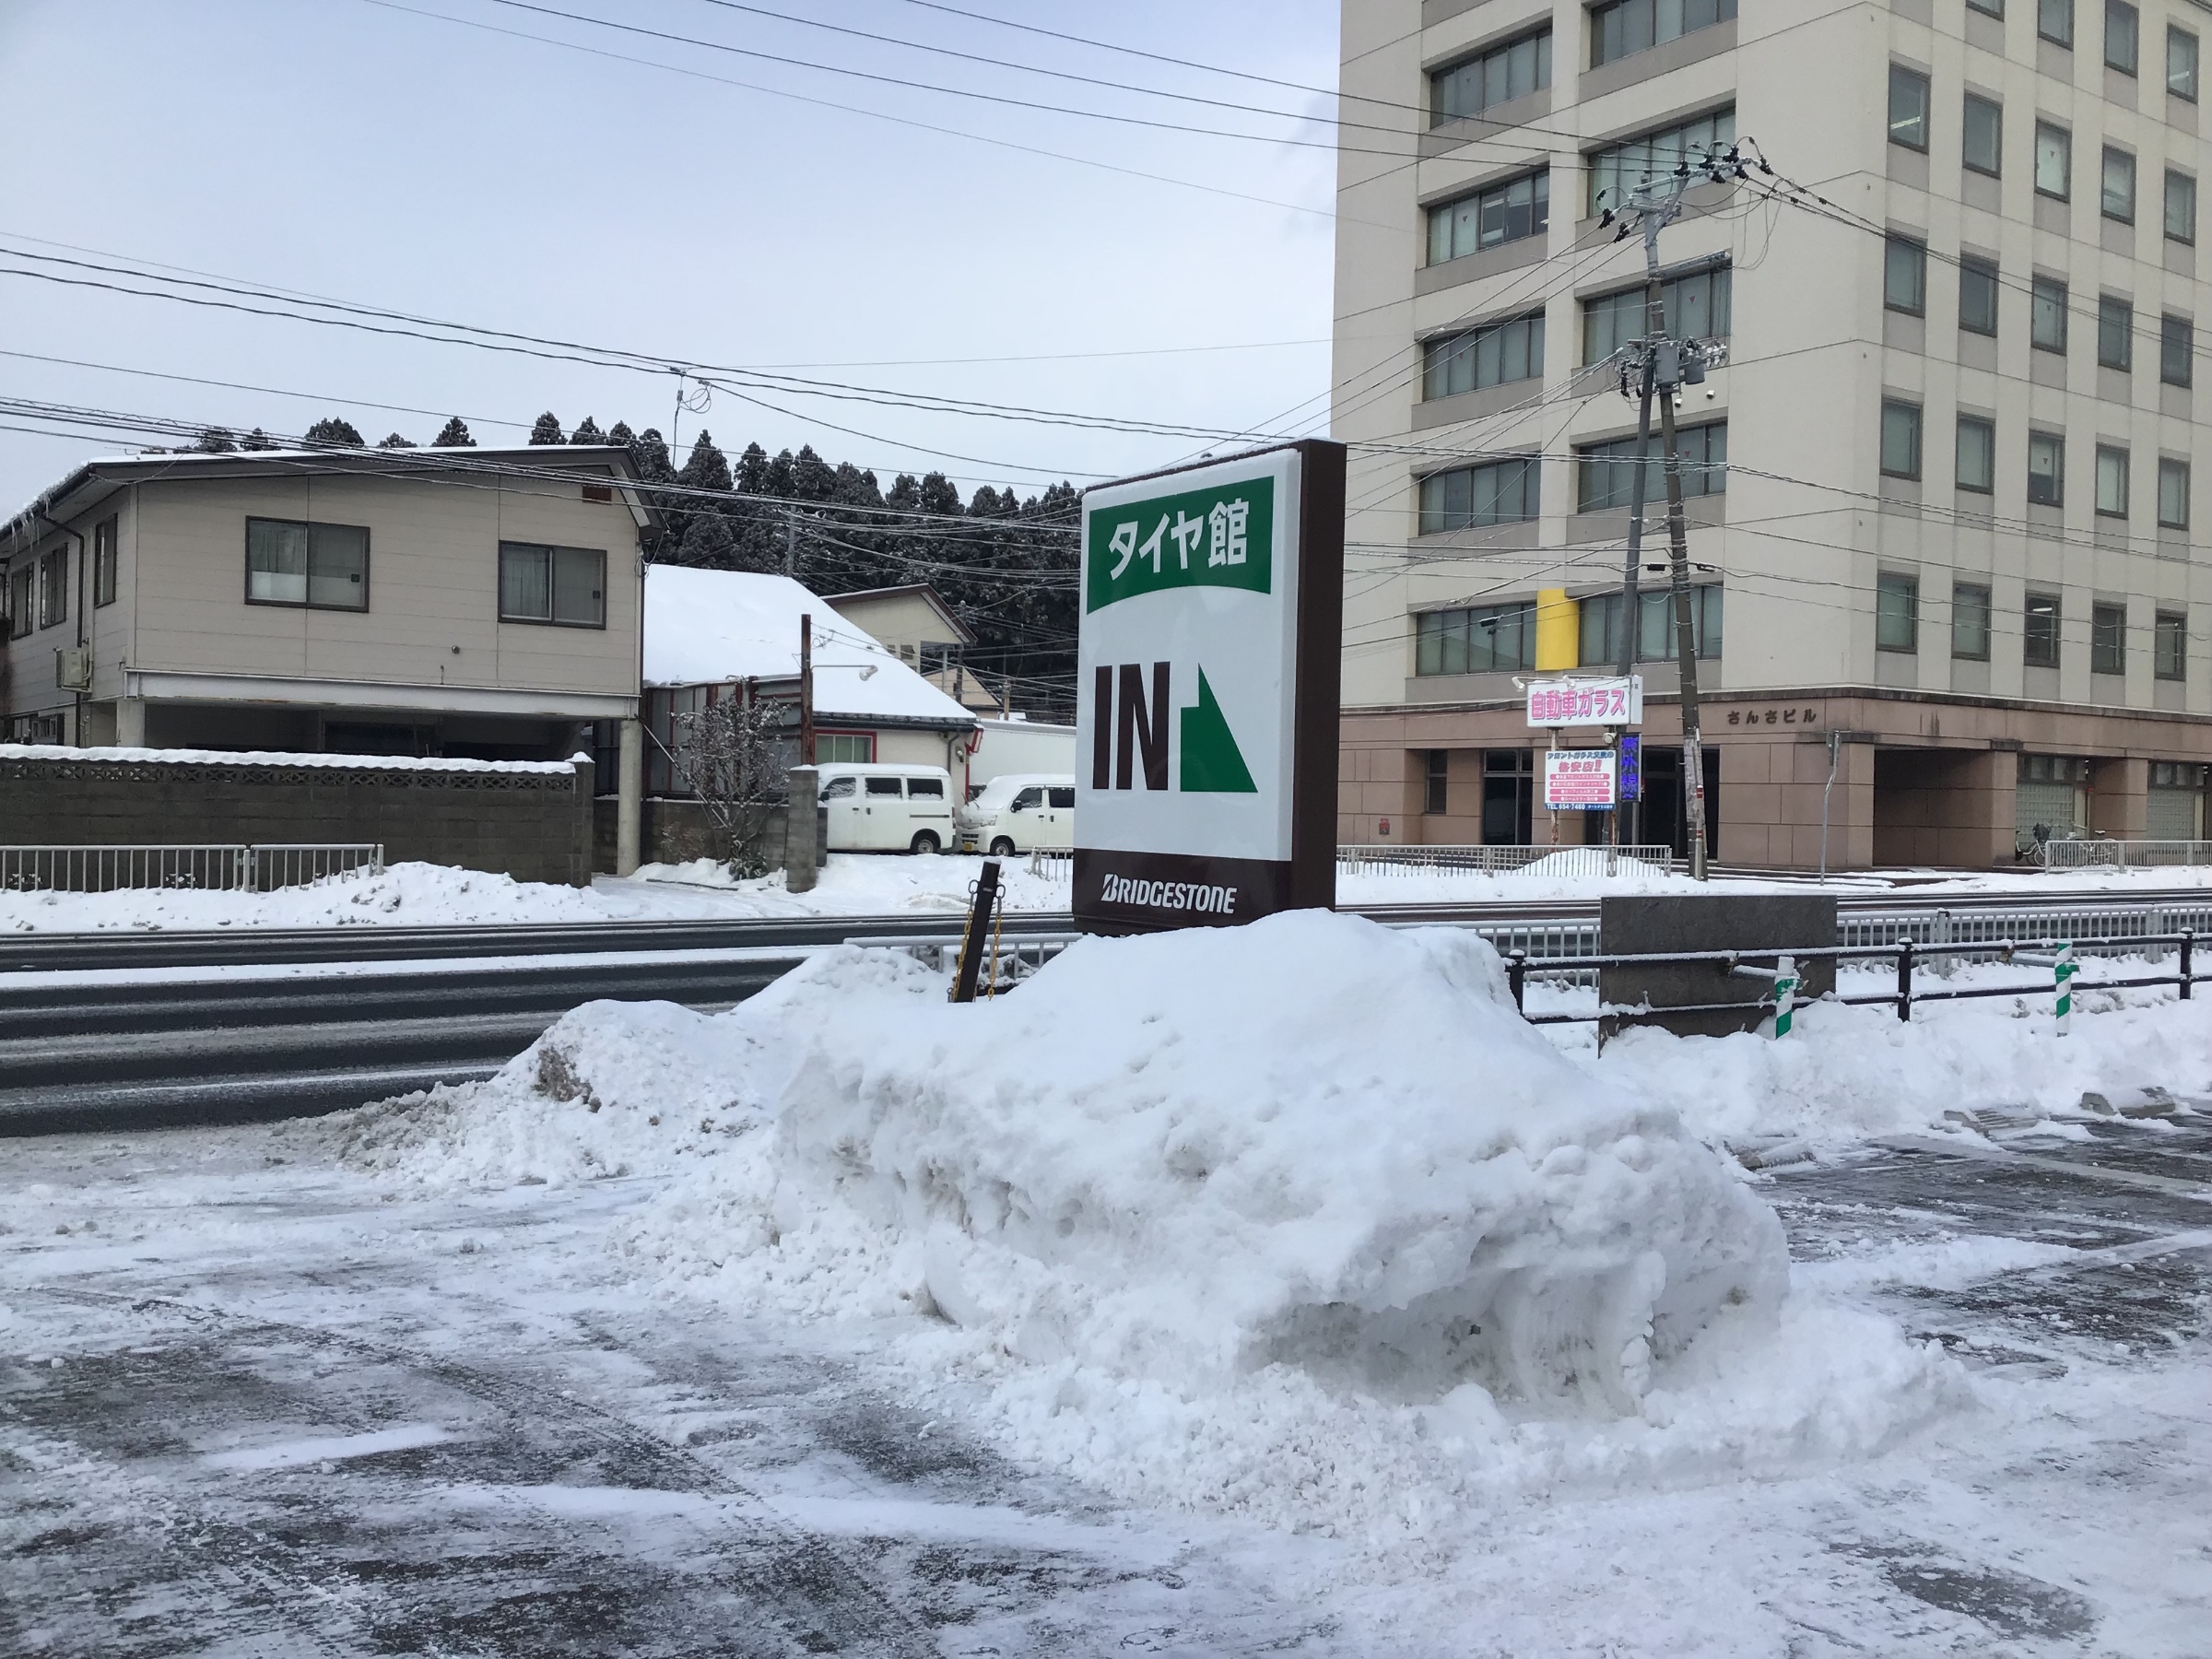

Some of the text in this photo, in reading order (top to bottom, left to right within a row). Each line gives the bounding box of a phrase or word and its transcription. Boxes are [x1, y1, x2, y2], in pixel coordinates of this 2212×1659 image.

[1108, 498, 1250, 581] タイヤ館
[1531, 688, 1626, 720] 自動車ガラス
[1727, 708, 1817, 725] さんさビル
[1092, 661, 1171, 791] IN
[1100, 874, 1238, 914] BRIDGESTONE
